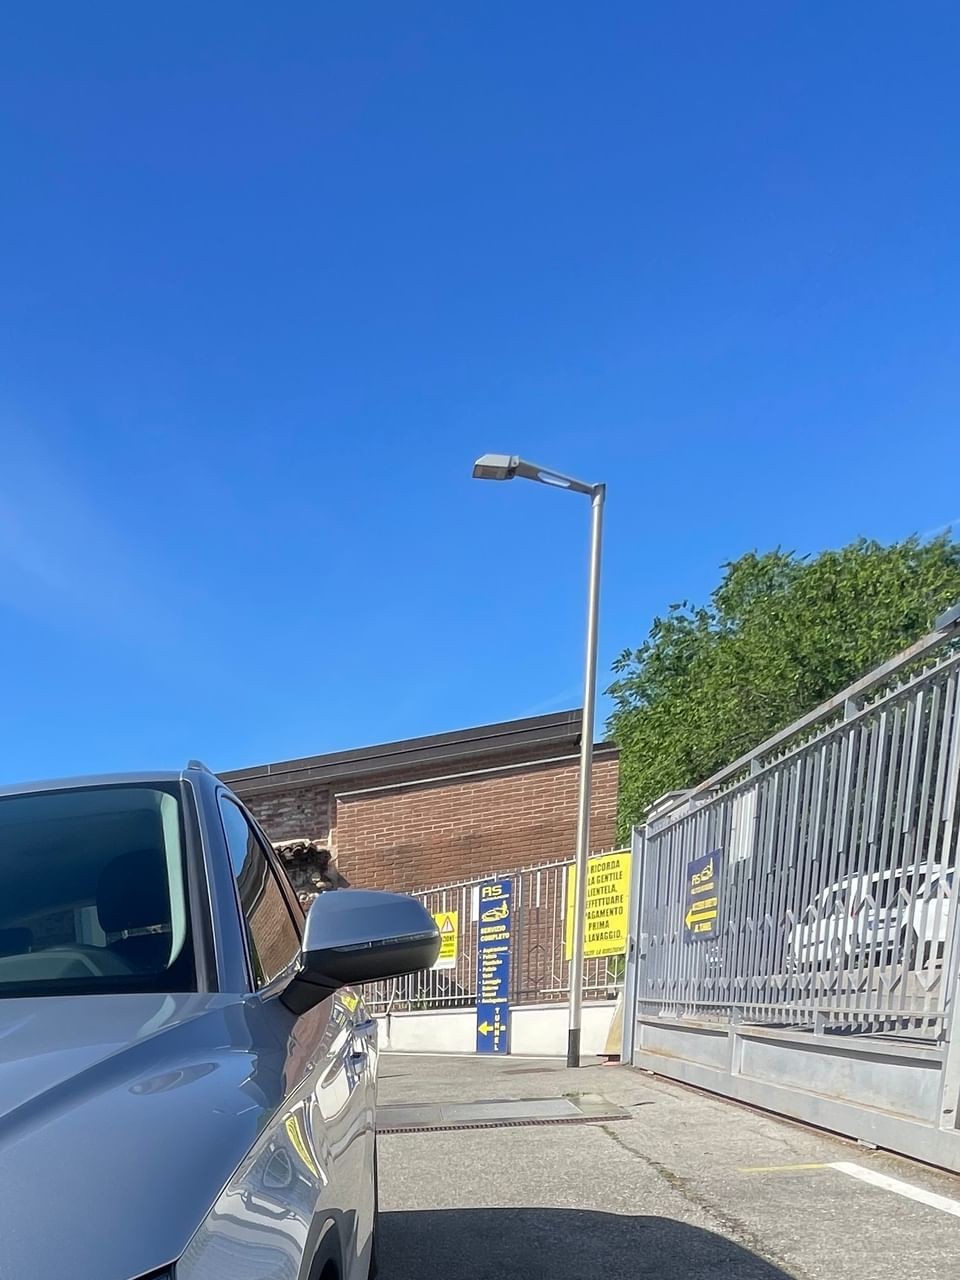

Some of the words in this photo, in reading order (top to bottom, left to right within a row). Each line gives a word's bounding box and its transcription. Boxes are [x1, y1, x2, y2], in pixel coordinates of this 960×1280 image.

[590, 860, 620, 874] RICORDA
[597, 871, 623, 884] GENTILE
[482, 885, 502, 898] AS
[588, 884, 617, 897] LIENTELA,
[589, 920, 609, 931] PRIMA
[480, 932, 510, 942] COMPLETO
